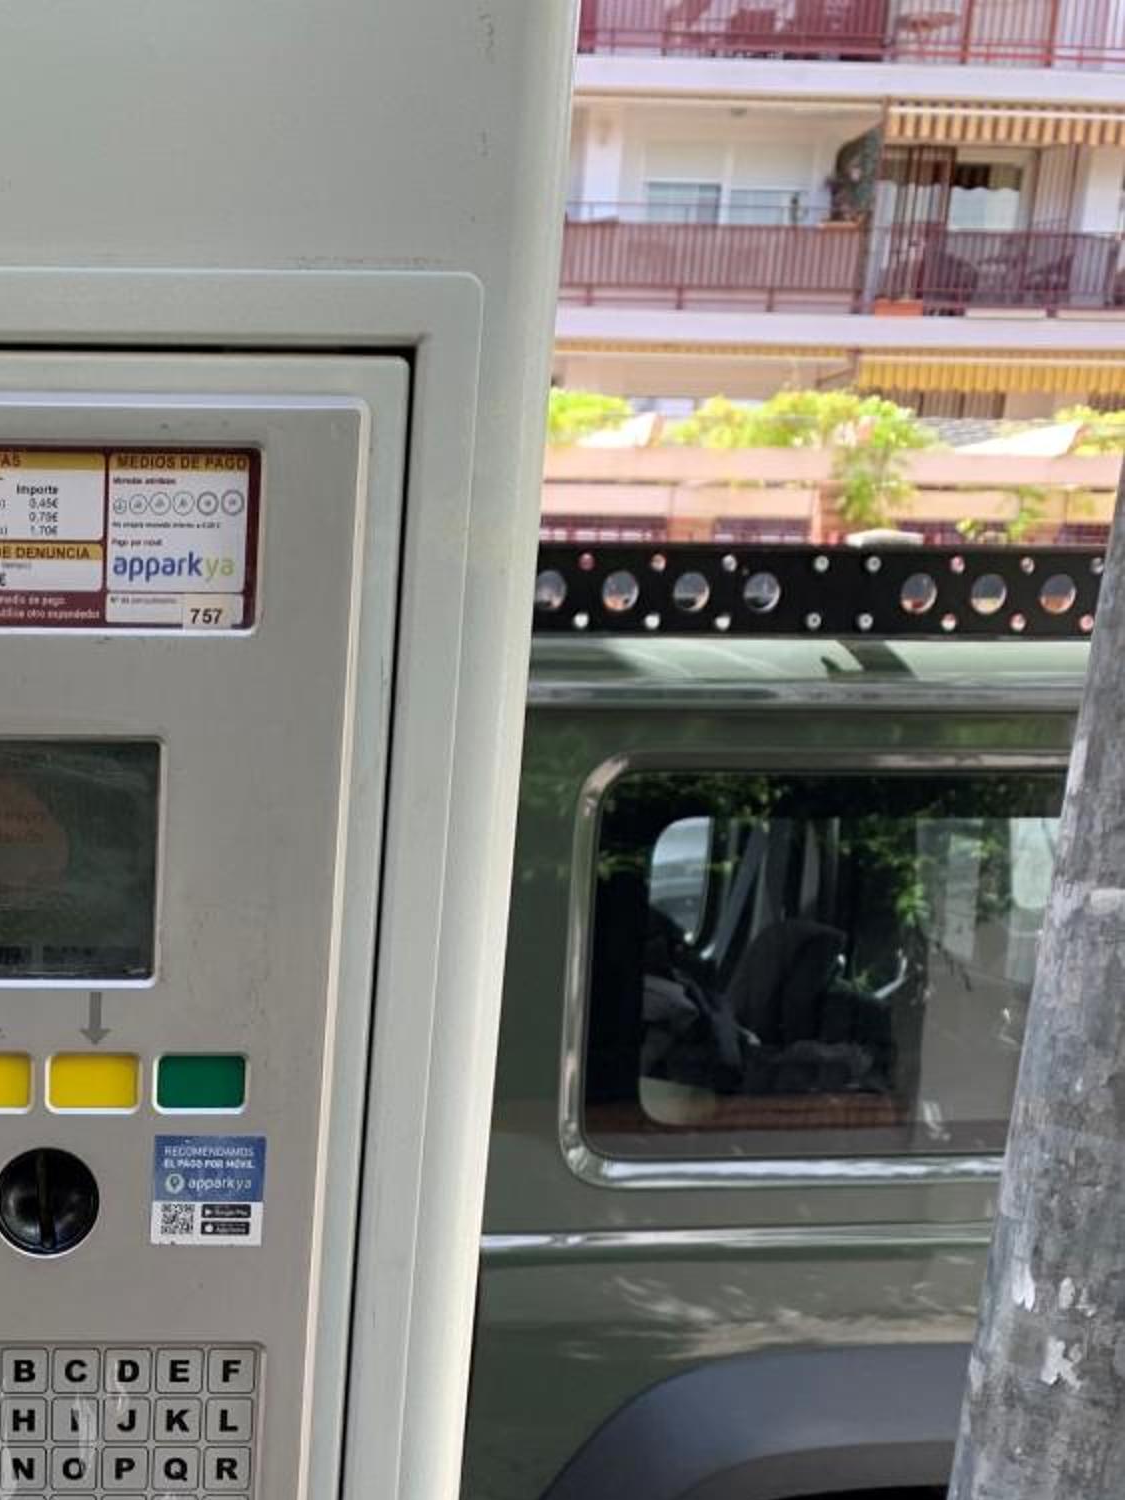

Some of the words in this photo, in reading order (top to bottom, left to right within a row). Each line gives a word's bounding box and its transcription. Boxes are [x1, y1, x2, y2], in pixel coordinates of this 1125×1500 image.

[116, 455, 176, 469] MEDIOS
[180, 456, 201, 469] DE
[204, 457, 247, 470] PAGO
[15, 484, 59, 496] Importe
[15, 547, 91, 560] DENUNCIA
[190, 608, 223, 624] 757
[164, 1146, 254, 1157] RECOMENDAMOS
[164, 1159, 174, 1169] EL
[177, 1159, 203, 1169] PAGO
[205, 1160, 224, 1169] POR
[13, 1359, 36, 1383] B
[64, 1359, 87, 1383] C
[117, 1359, 140, 1383] D
[169, 1359, 190, 1383] E
[221, 1359, 242, 1383] F
[12, 1409, 36, 1432] H
[70, 1409, 80, 1432] I
[117, 1409, 137, 1432] J
[165, 1408, 190, 1433] K
[219, 1408, 239, 1433] L
[12, 1457, 35, 1481] N
[62, 1457, 85, 1481] O
[114, 1457, 136, 1480] P
[163, 1457, 188, 1482] Q
[216, 1457, 238, 1481] R
